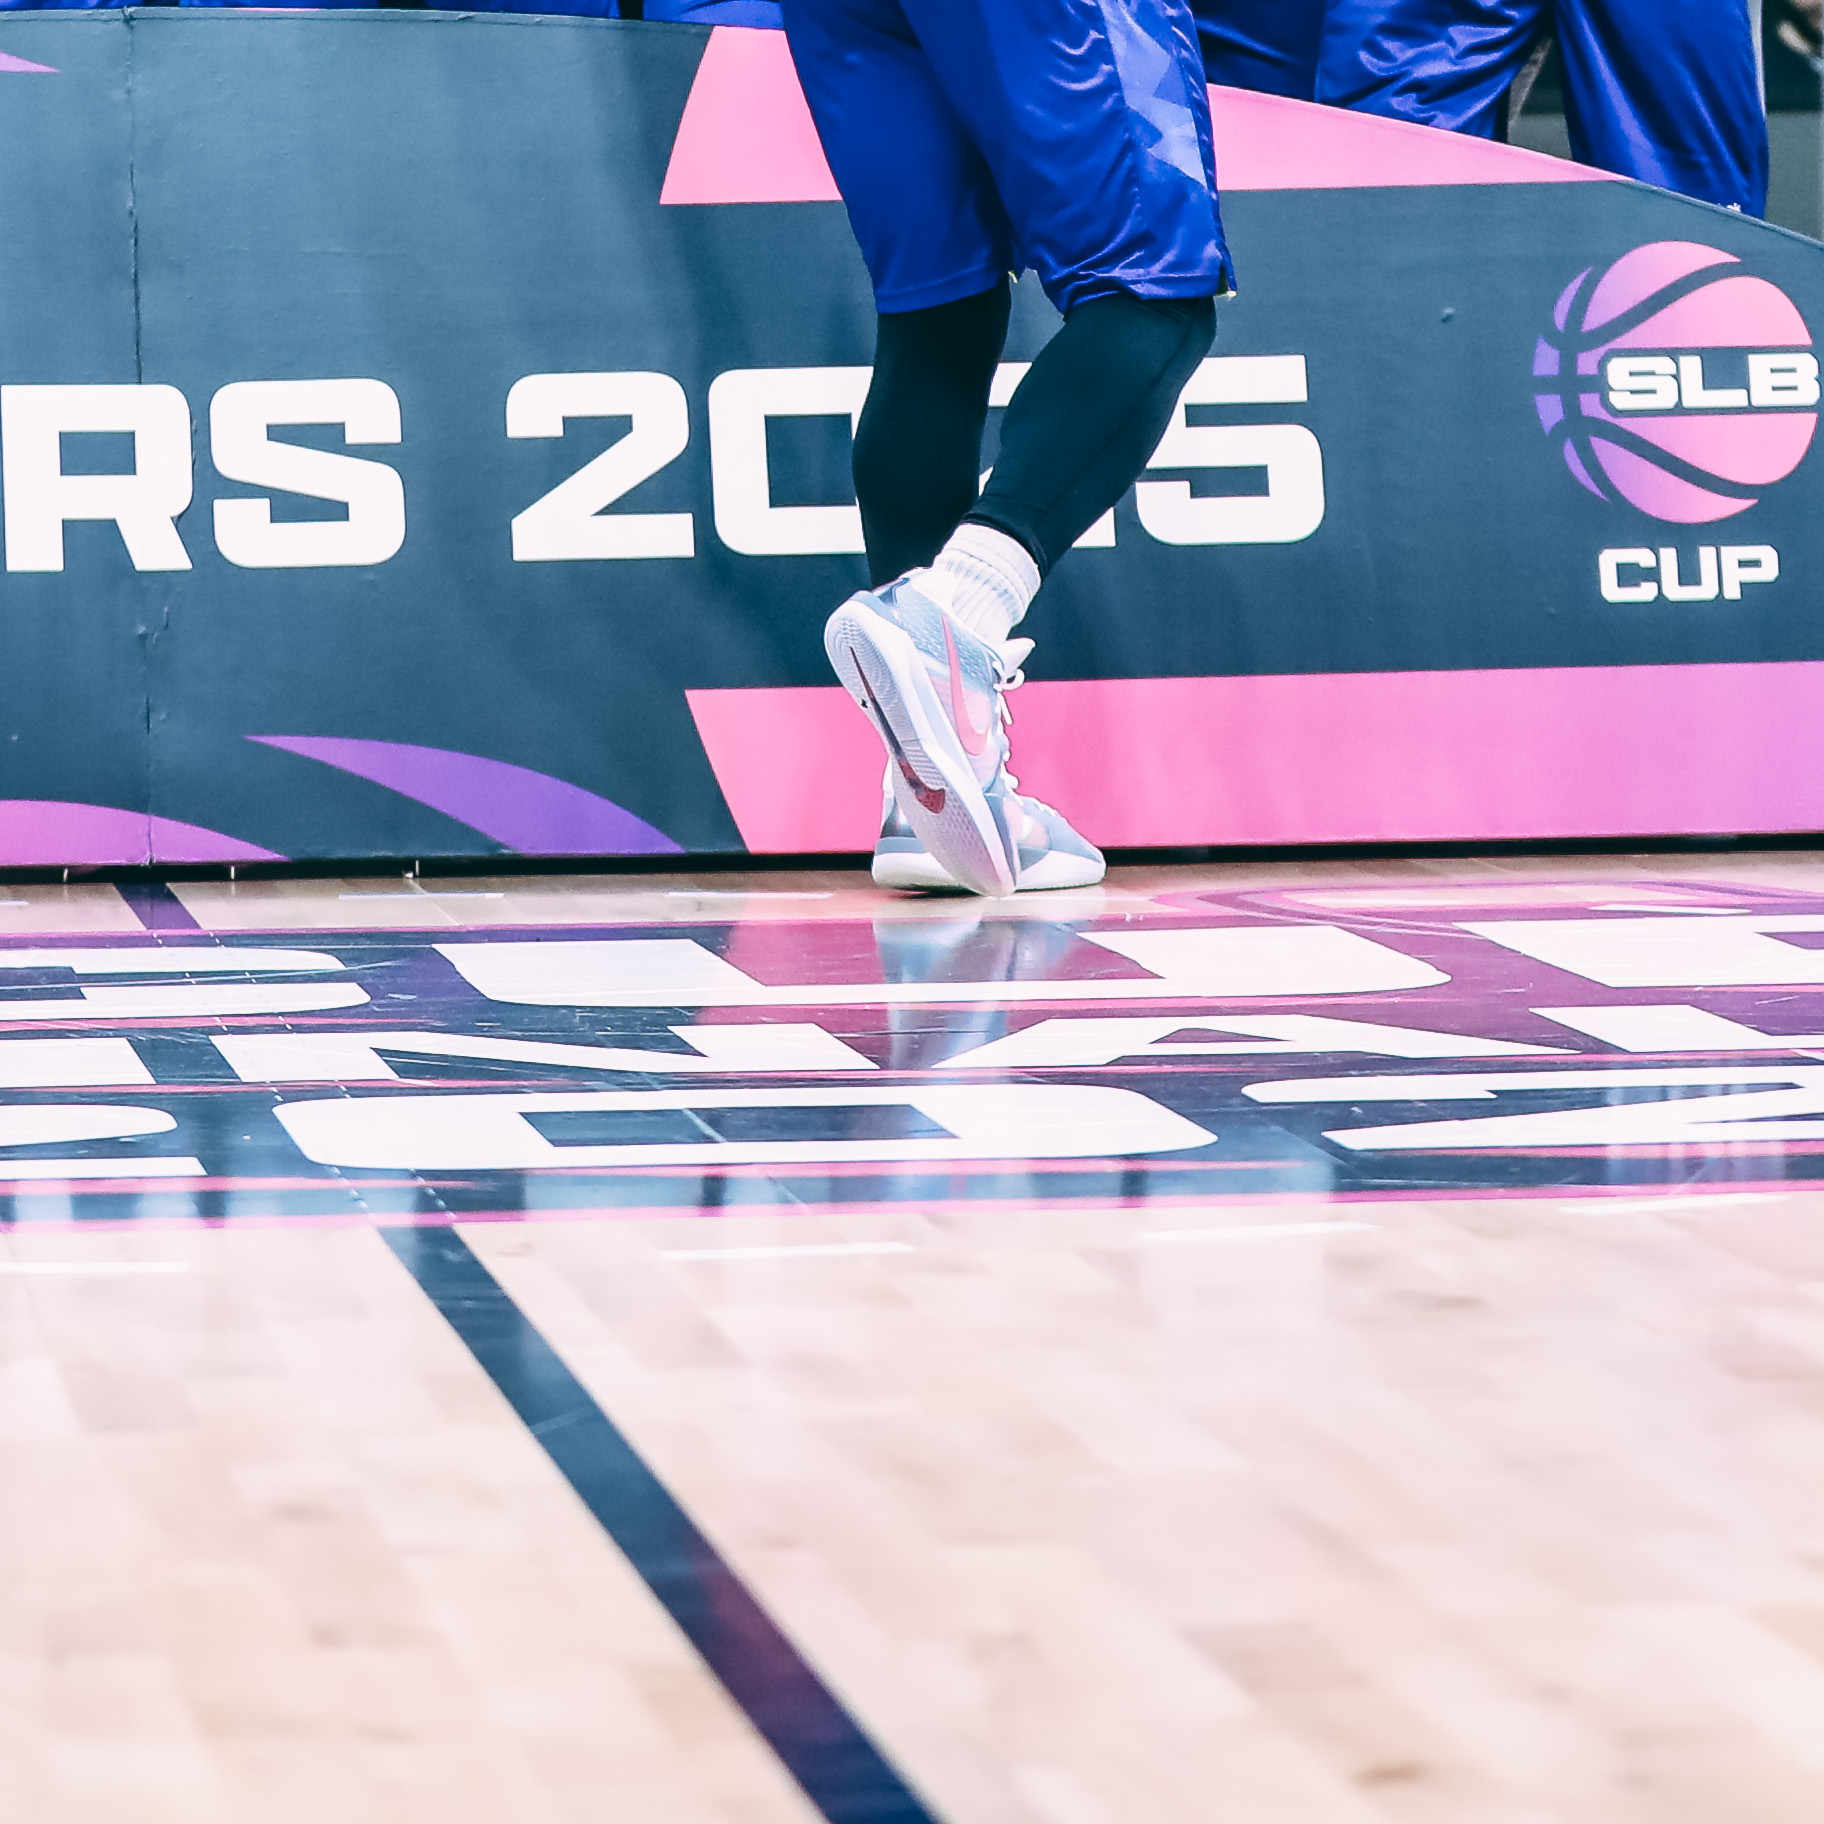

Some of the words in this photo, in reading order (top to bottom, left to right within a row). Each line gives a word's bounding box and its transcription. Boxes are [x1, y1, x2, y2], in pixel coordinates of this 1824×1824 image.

[1605, 350, 1822, 410] SLB
[504, 354, 1326, 562] 205
[1597, 543, 1780, 604] CUP
